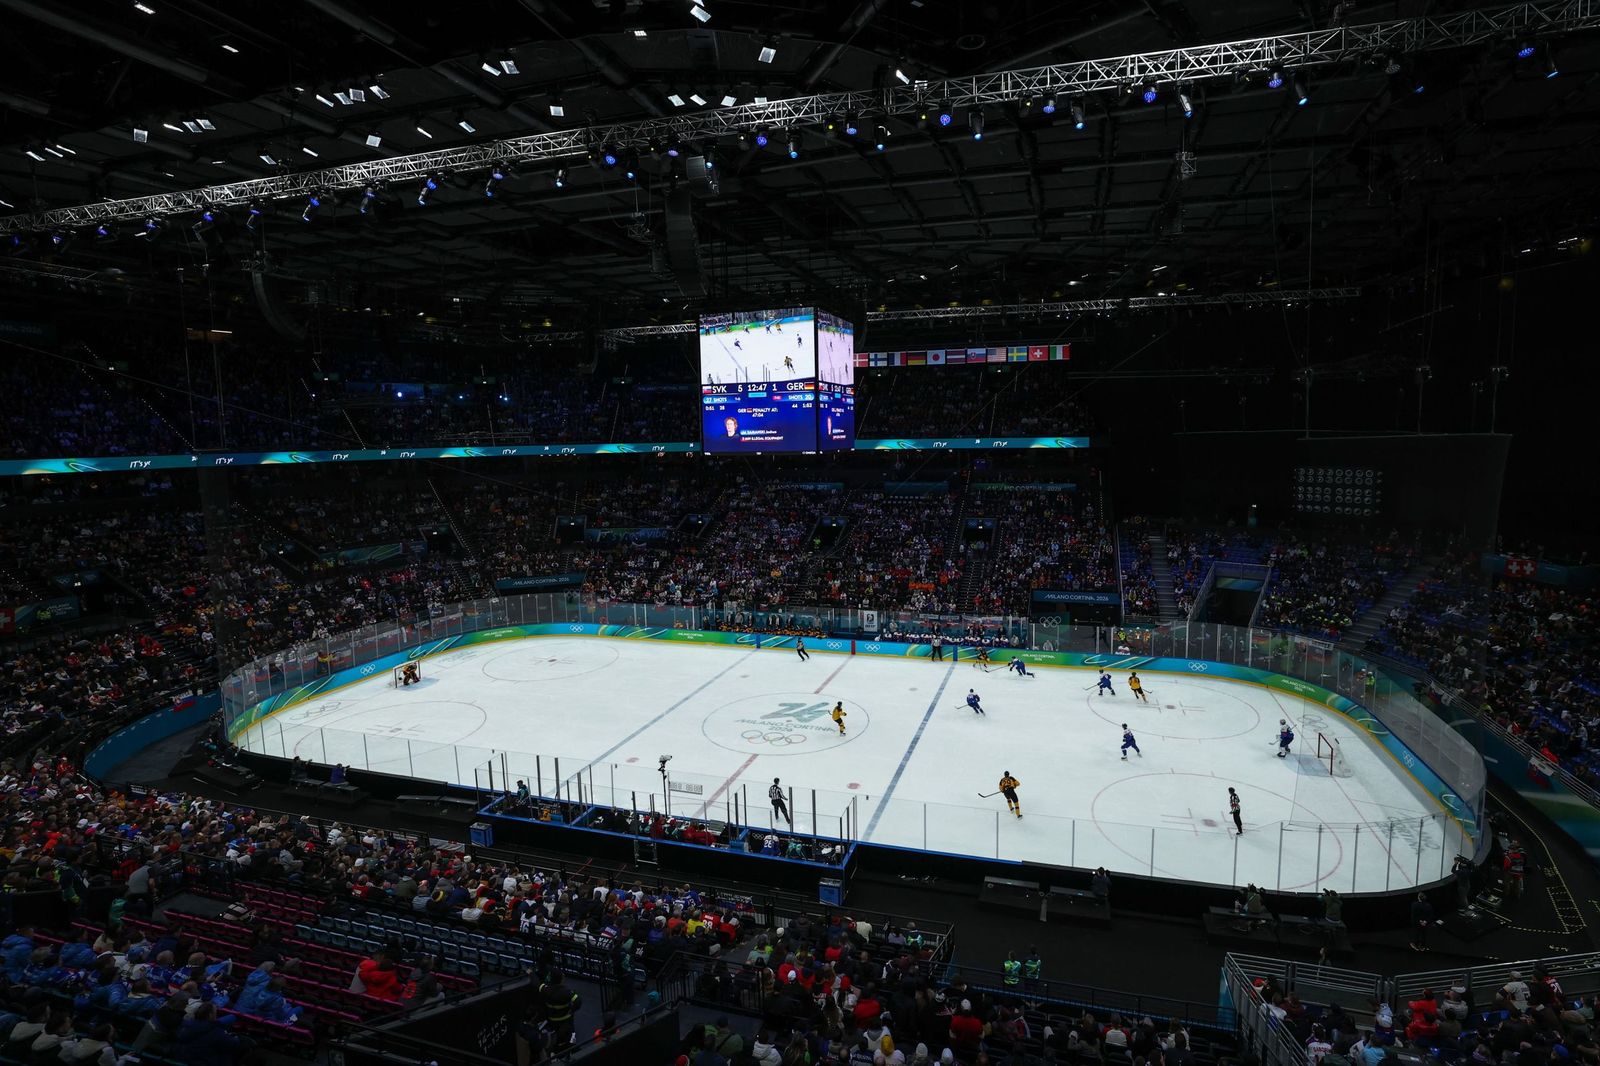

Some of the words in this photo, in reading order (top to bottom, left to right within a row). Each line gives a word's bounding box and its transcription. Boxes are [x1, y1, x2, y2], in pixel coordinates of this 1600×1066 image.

[712, 385, 727, 394] SVK
[786, 382, 804, 390] GER
[734, 718, 784, 727] MILANO
[786, 722, 836, 733] CORTINA
